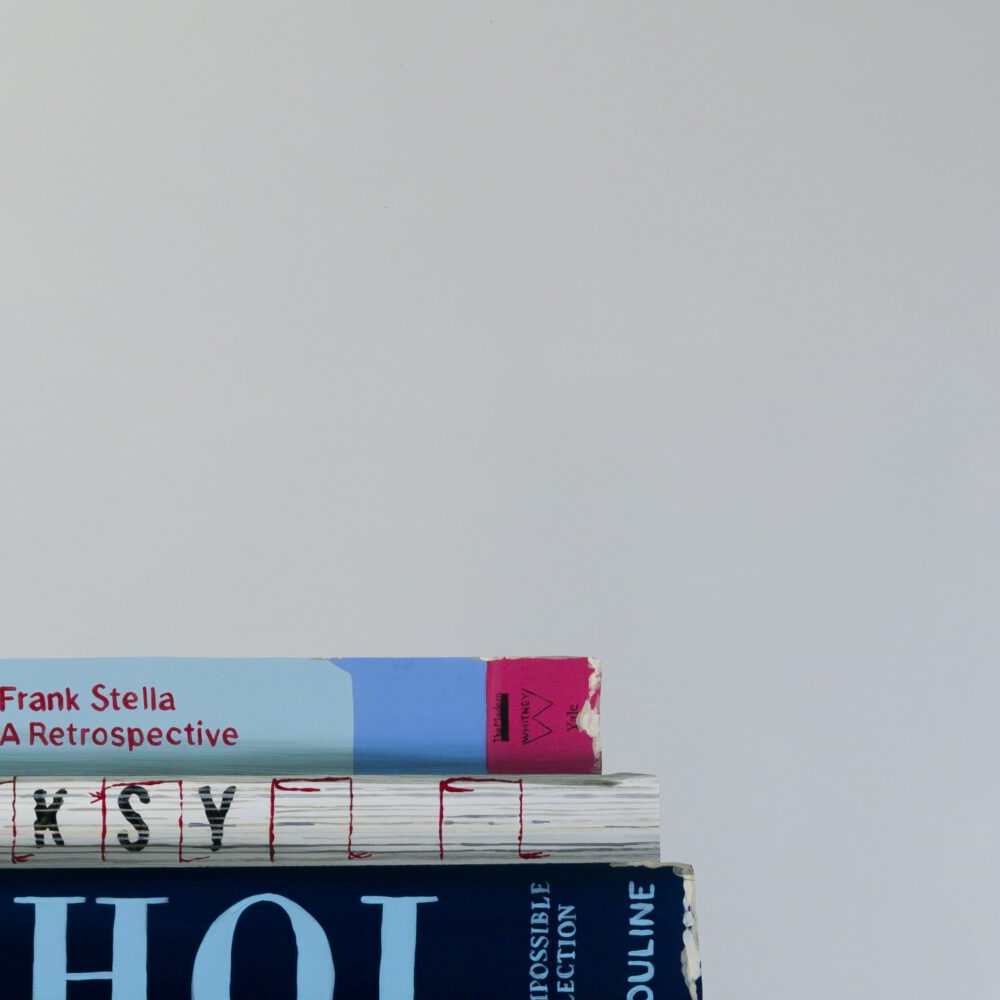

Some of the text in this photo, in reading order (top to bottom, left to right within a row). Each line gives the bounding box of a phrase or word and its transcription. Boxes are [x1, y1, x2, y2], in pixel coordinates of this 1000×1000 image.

[90, 683, 176, 712] Stella
[521, 693, 530, 744] WHITNEY
[566, 704, 579, 732] Yale
[0, 720, 239, 751] A Retrospective
